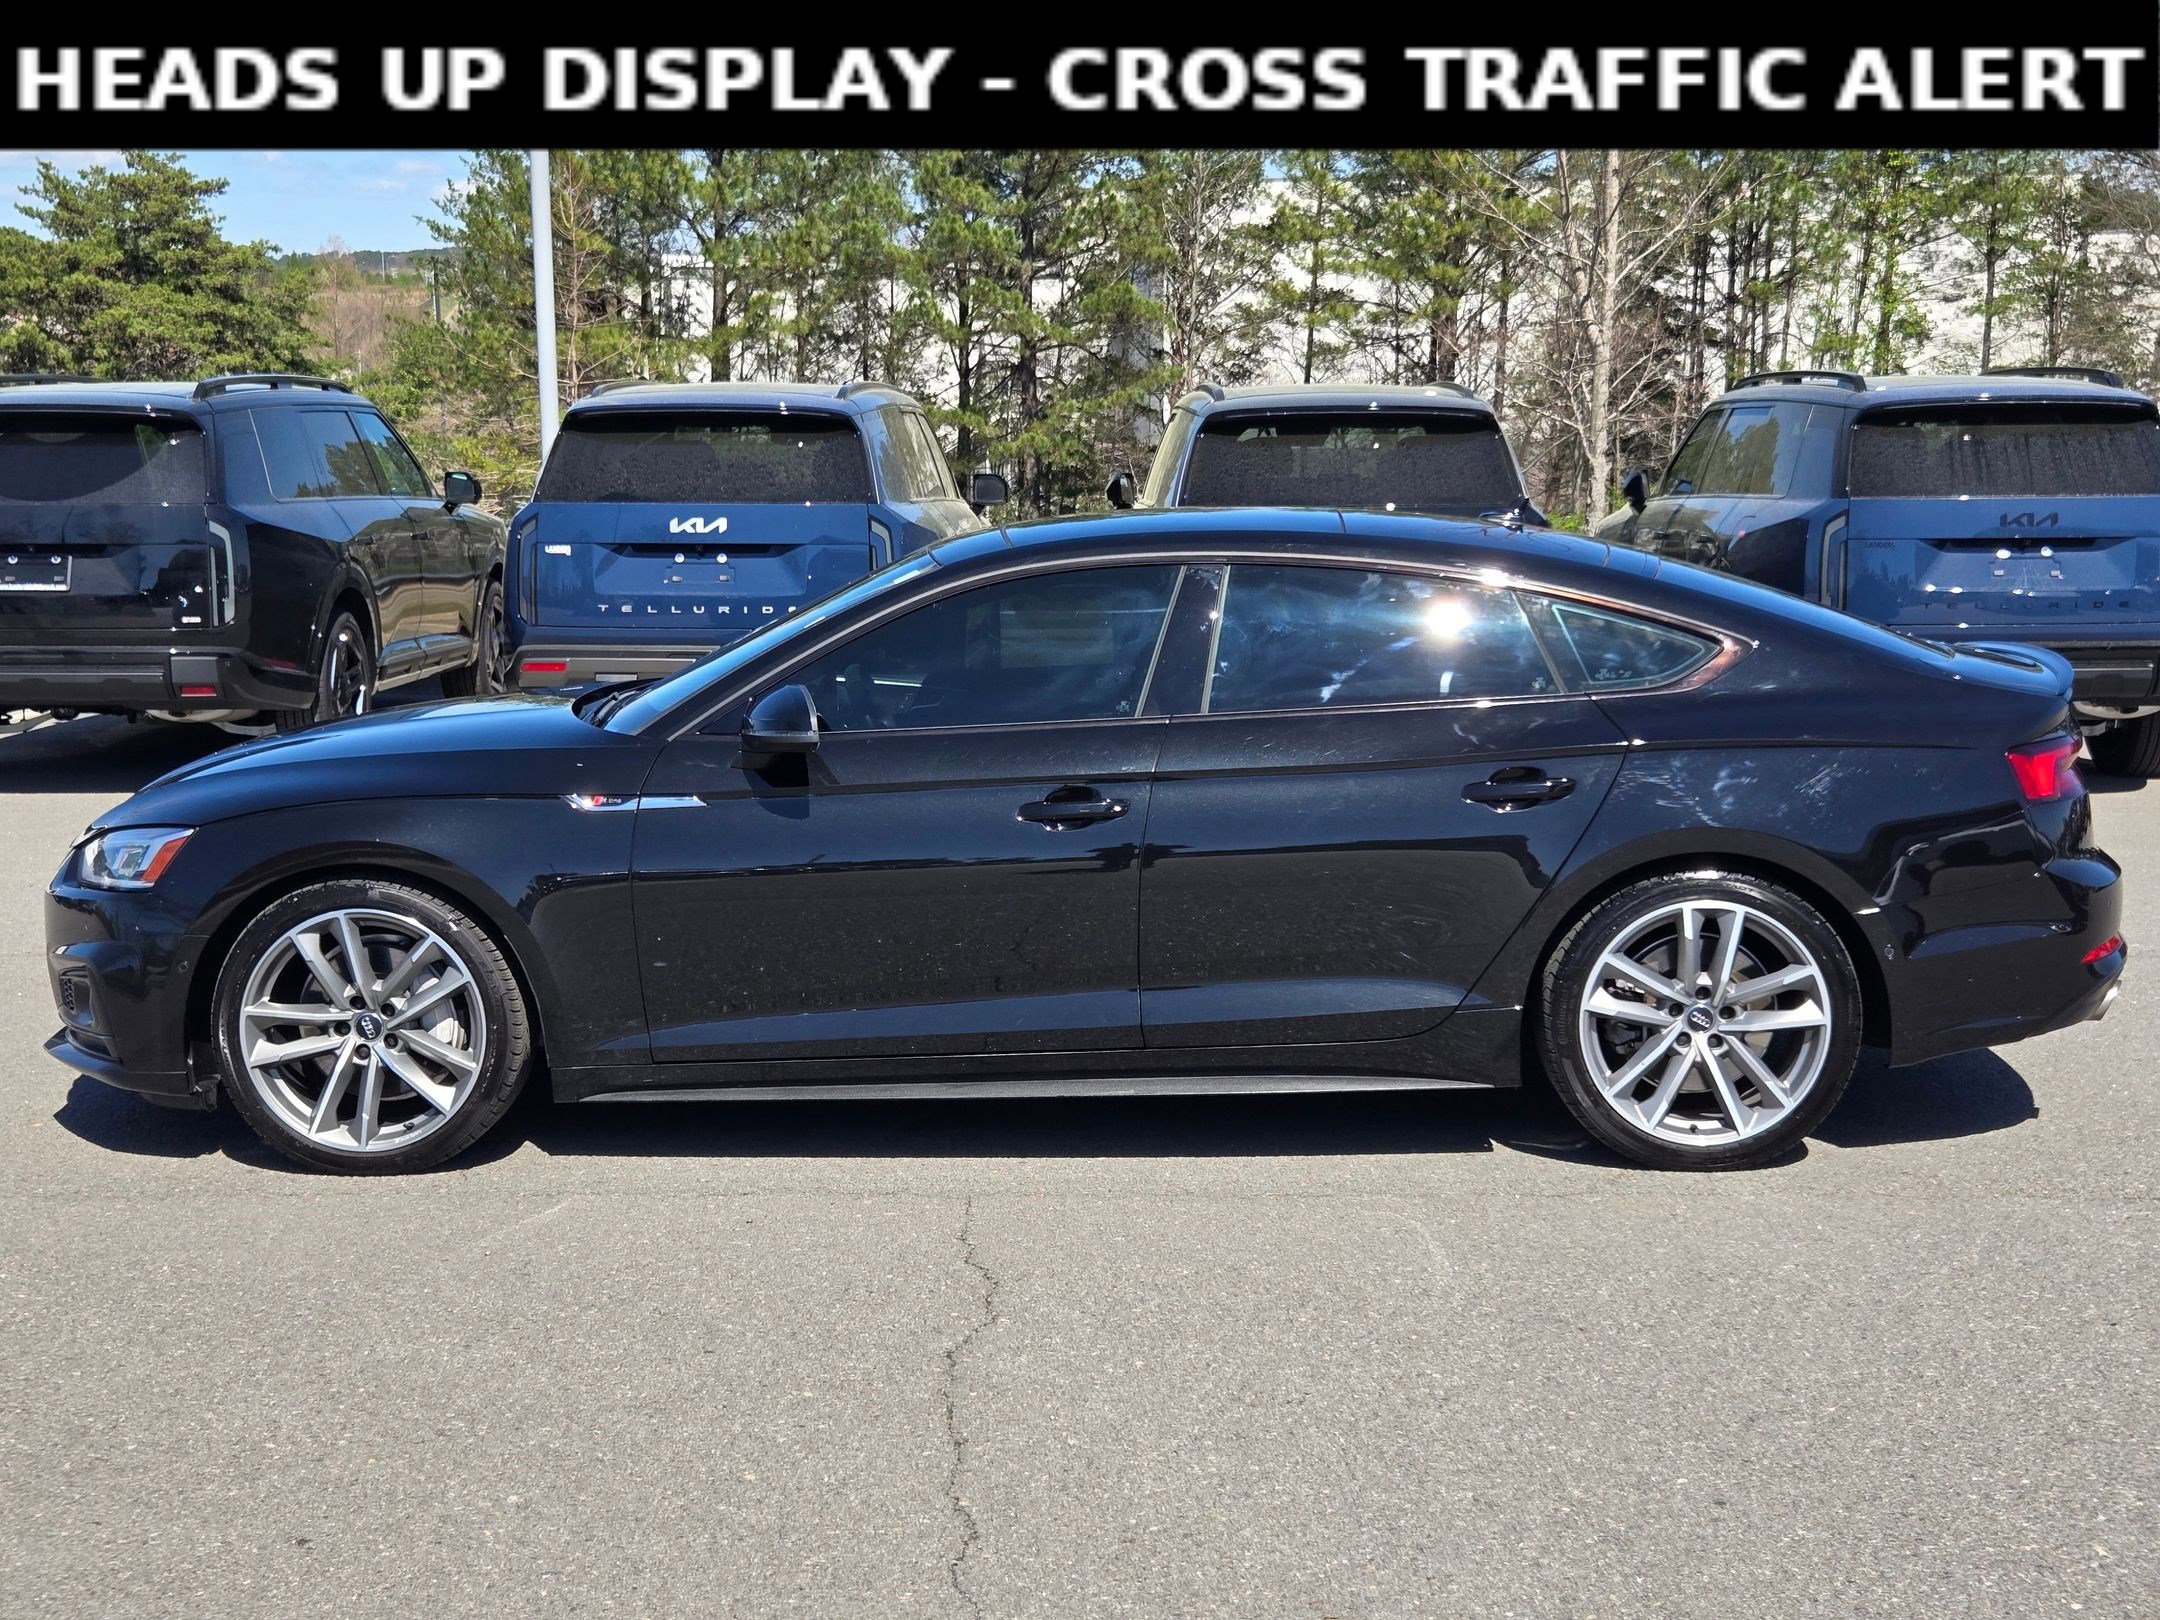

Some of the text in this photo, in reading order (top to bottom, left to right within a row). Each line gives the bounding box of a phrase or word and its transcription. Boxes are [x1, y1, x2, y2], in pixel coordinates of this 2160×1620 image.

[669, 517, 728, 534] KIA
[1999, 512, 2058, 527] KIA
[1924, 601, 2130, 609] TELLURIDE
